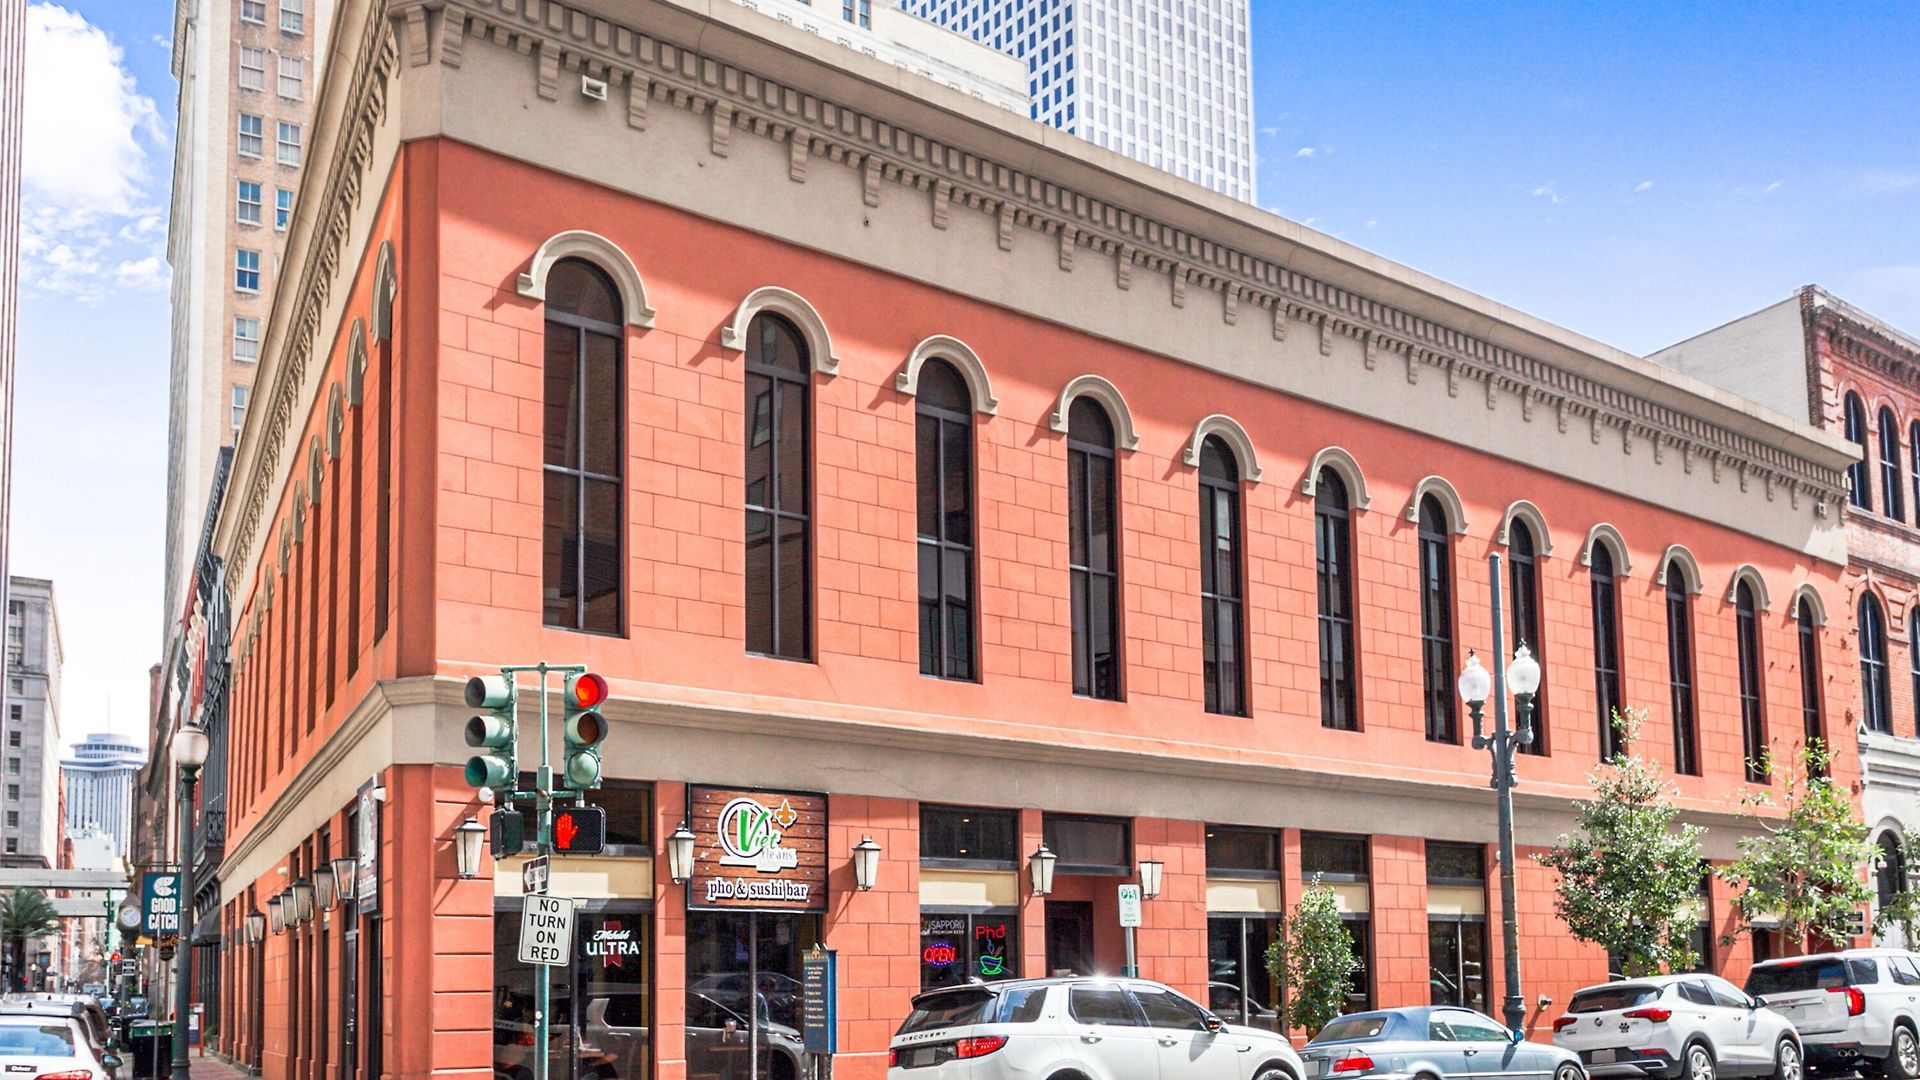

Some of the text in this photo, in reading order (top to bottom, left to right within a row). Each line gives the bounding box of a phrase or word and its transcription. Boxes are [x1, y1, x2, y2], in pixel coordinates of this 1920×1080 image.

[740, 809, 777, 852] Viet
[710, 880, 807, 897] pho & sushi bar
[151, 898, 176, 913] GOOD
[540, 899, 559, 912] NO
[148, 914, 178, 929] CATCH
[530, 914, 566, 929] TURN
[931, 920, 965, 930] SAPPORO
[537, 931, 556, 944] ON
[531, 947, 560, 960] RED
[586, 941, 640, 955] ULTRA
[924, 947, 956, 962] OPEN
[902, 1031, 947, 1042] DISCOVERY
